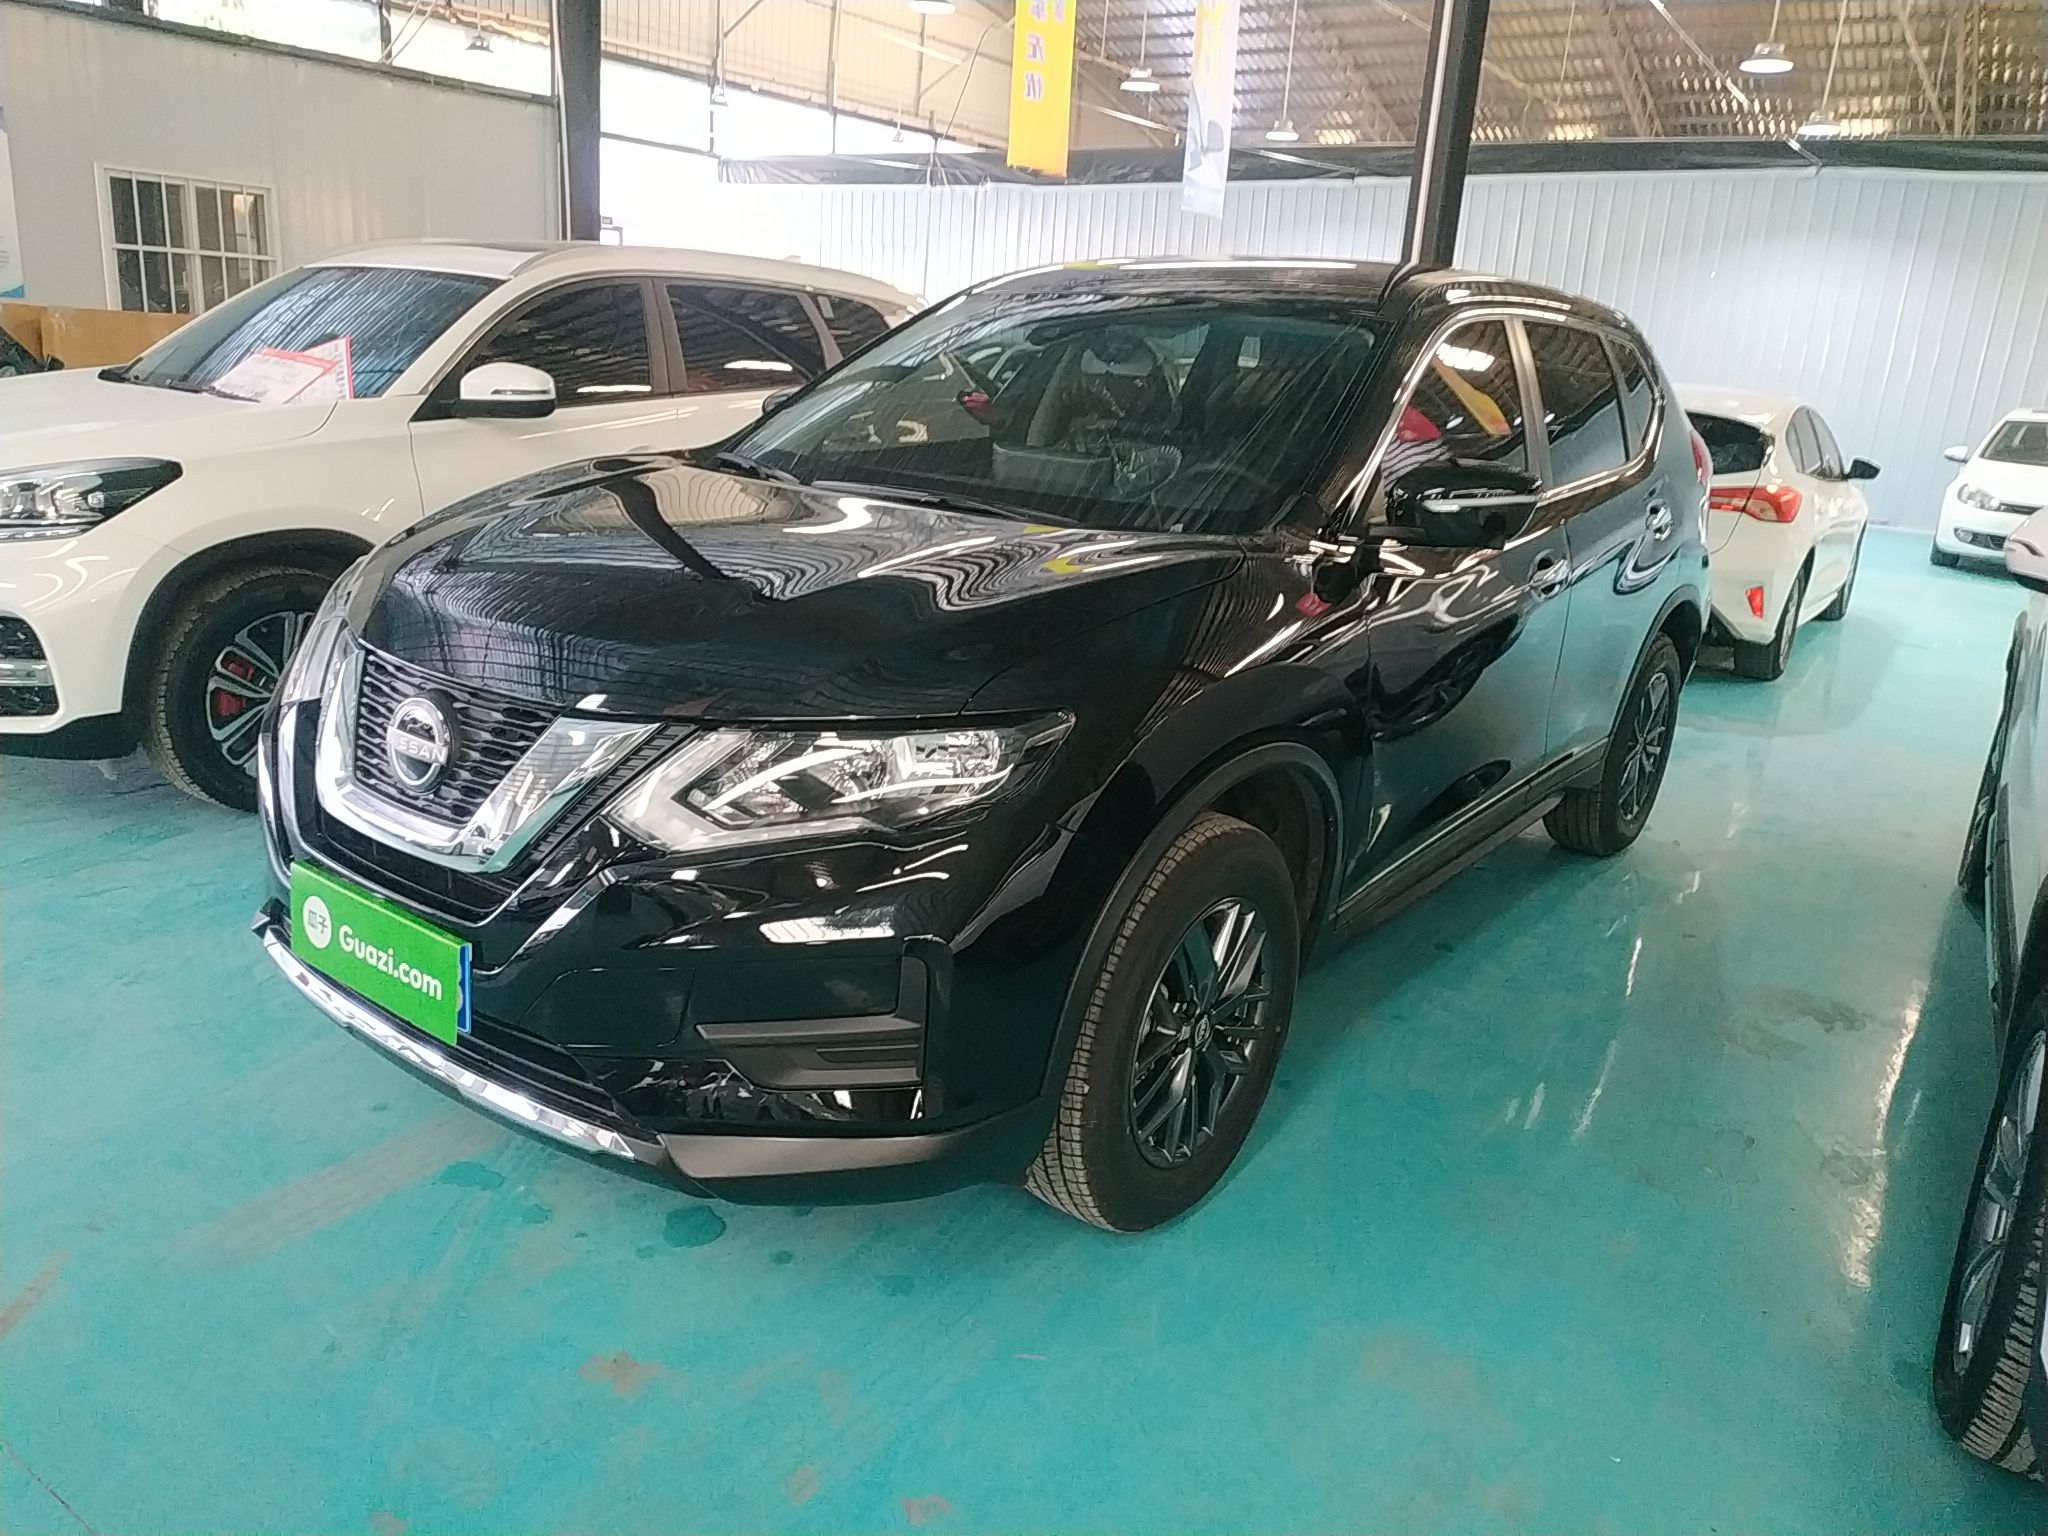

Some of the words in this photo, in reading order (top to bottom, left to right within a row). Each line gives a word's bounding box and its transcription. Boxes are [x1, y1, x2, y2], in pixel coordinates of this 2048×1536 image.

[389, 730, 446, 762] SSAN
[308, 909, 328, 934] 瓜子
[339, 924, 442, 1001] Guazi.com
